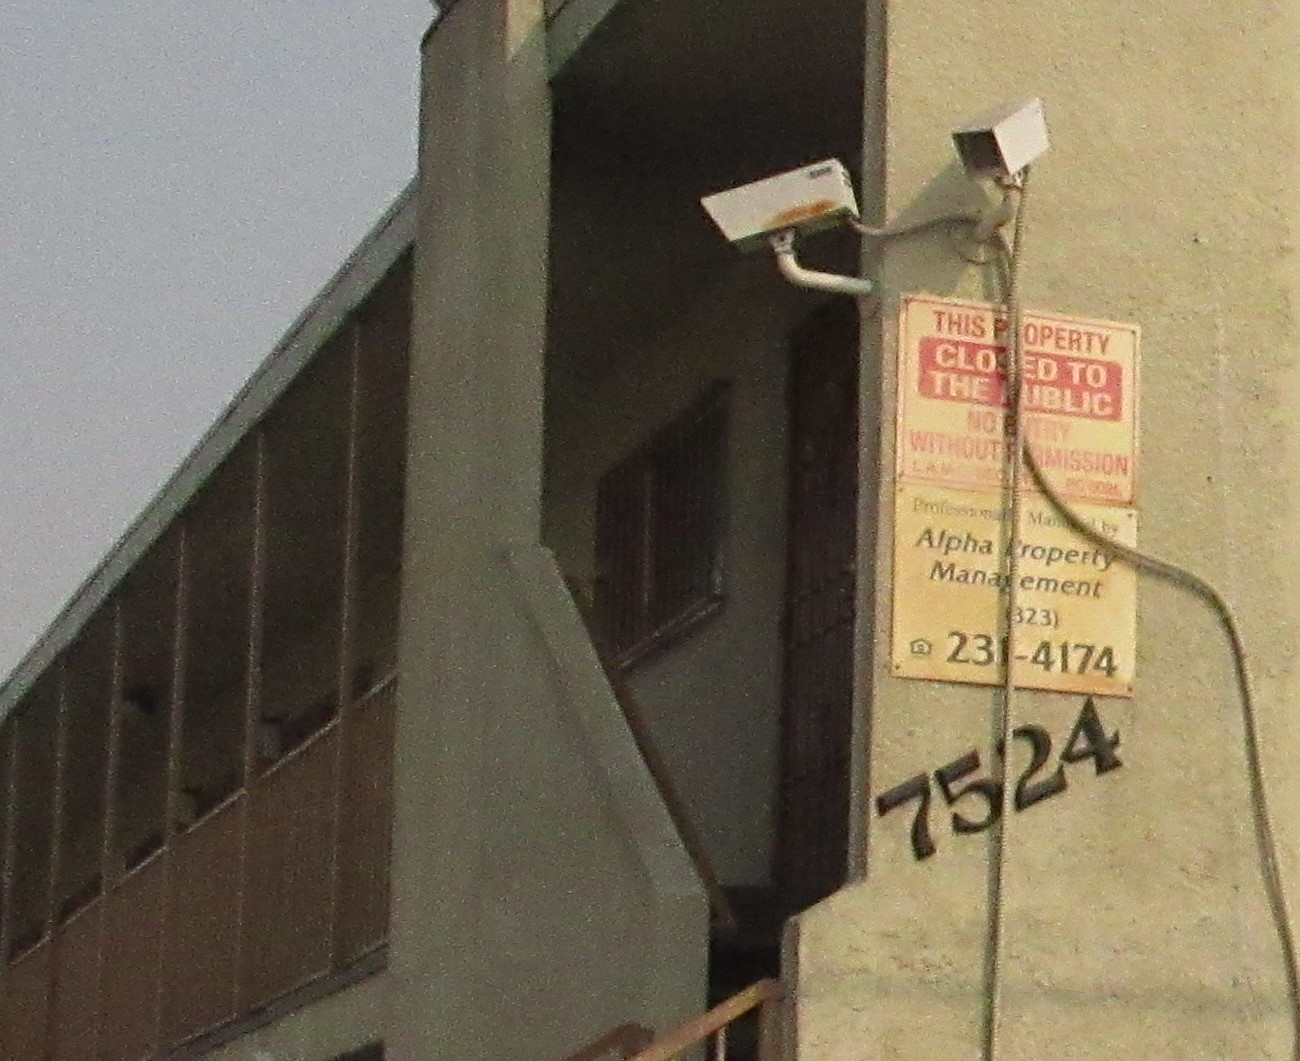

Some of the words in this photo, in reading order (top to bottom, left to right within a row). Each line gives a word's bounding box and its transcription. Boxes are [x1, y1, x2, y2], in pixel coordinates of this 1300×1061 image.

[934, 311, 985, 338] THIS
[995, 318, 1110, 354] POPERTY
[935, 344, 1058, 381] CLOED
[1067, 361, 1107, 388] TO
[931, 371, 990, 398] THE
[1000, 381, 1112, 416] UBLIC
[967, 411, 997, 433] NO
[914, 528, 993, 556] Alpha
[874, 697, 1123, 861] 7524
